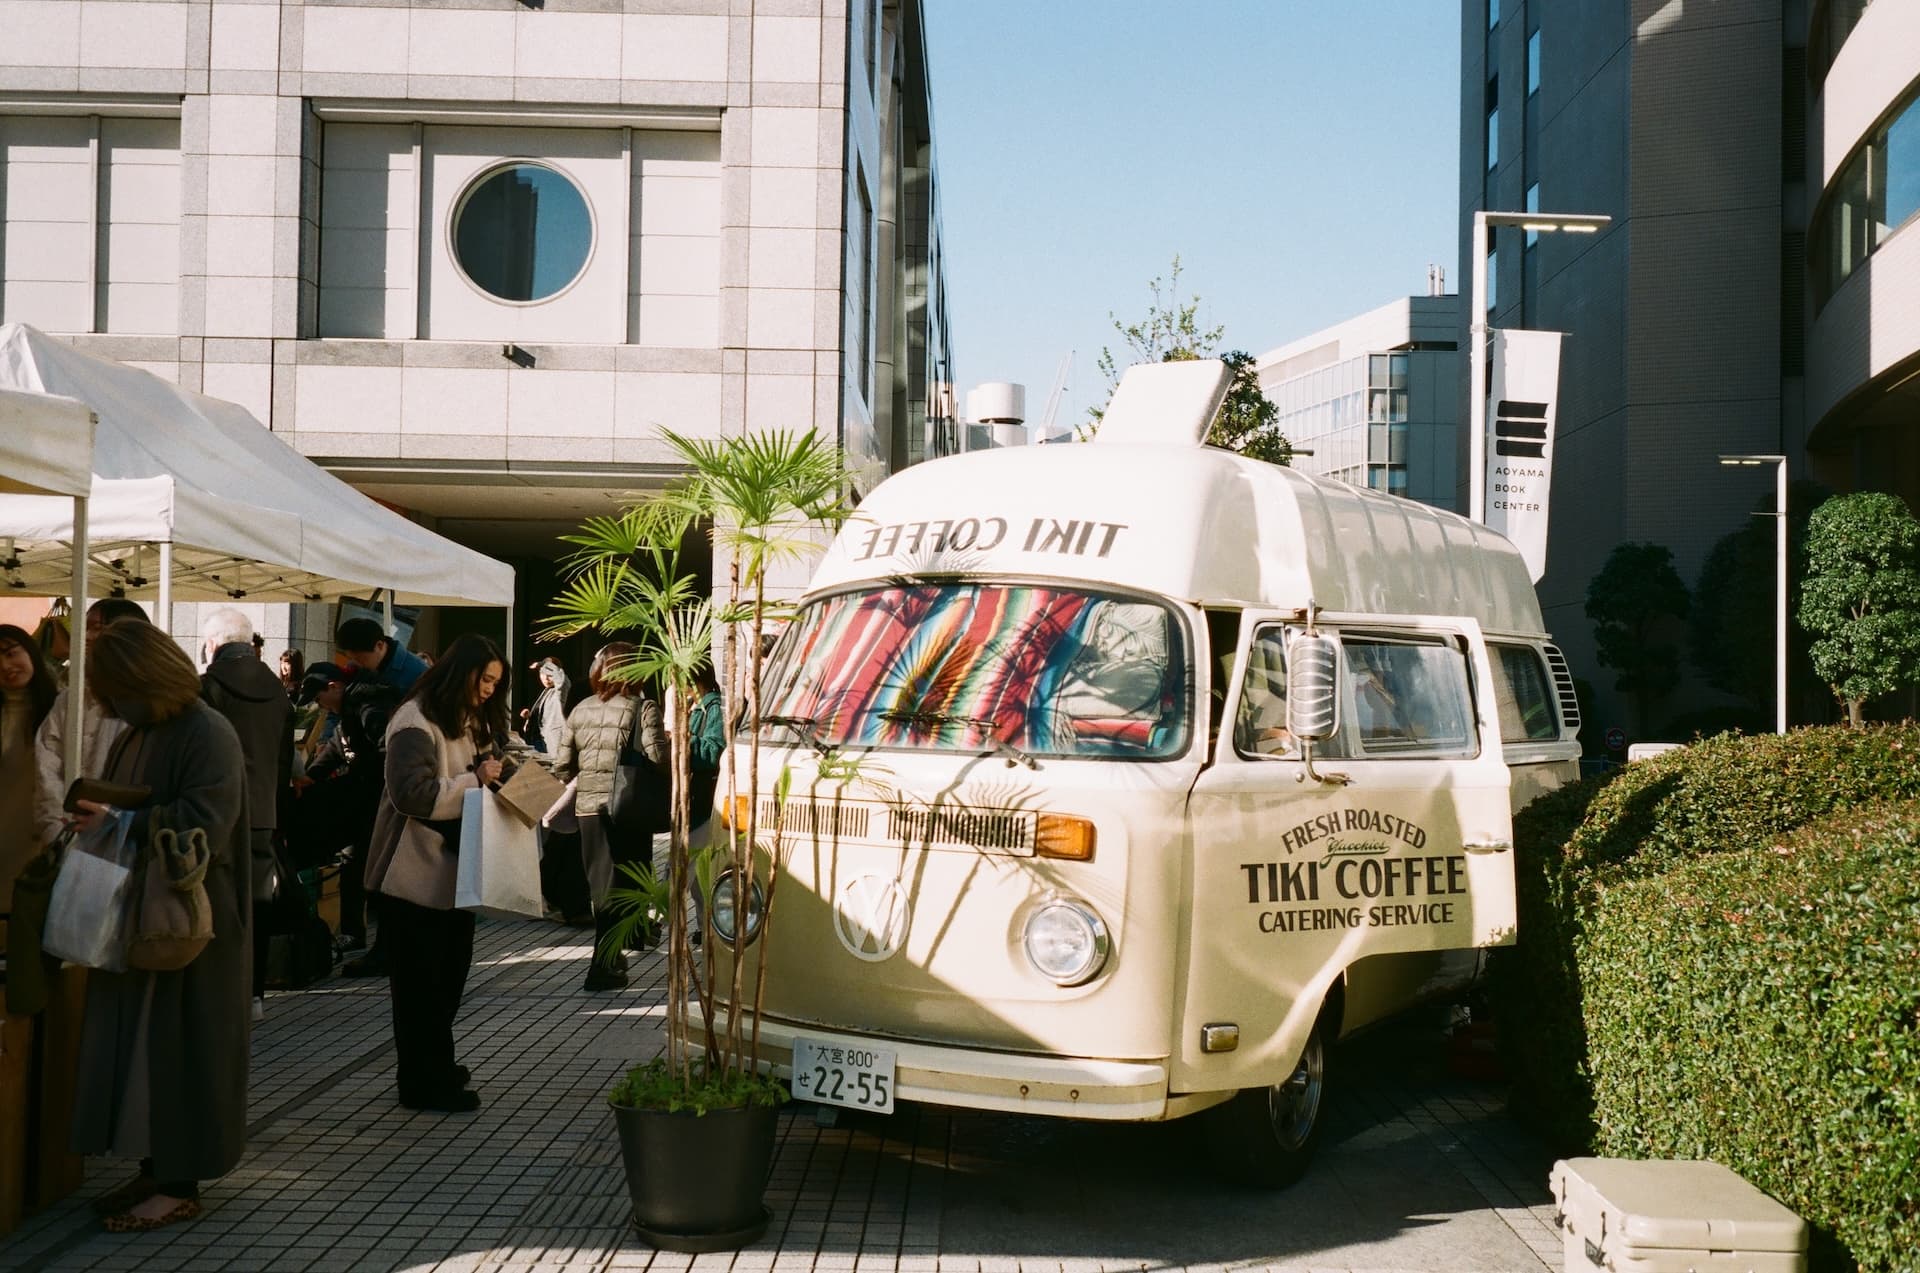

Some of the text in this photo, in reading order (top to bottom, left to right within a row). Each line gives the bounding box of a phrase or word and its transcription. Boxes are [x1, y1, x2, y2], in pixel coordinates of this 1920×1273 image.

[1495, 466, 1545, 478] AOYAMA
[1495, 483, 1526, 494] BOOK
[1494, 500, 1540, 512] CENTER
[1281, 808, 1427, 854] FRESH ROASTED
[1240, 855, 1467, 903] TIKI COFFEE
[1259, 903, 1454, 933] CATERING SERVICE
[816, 1045, 873, 1068] 大宮 800
[798, 1066, 889, 1107] せ 22-55
